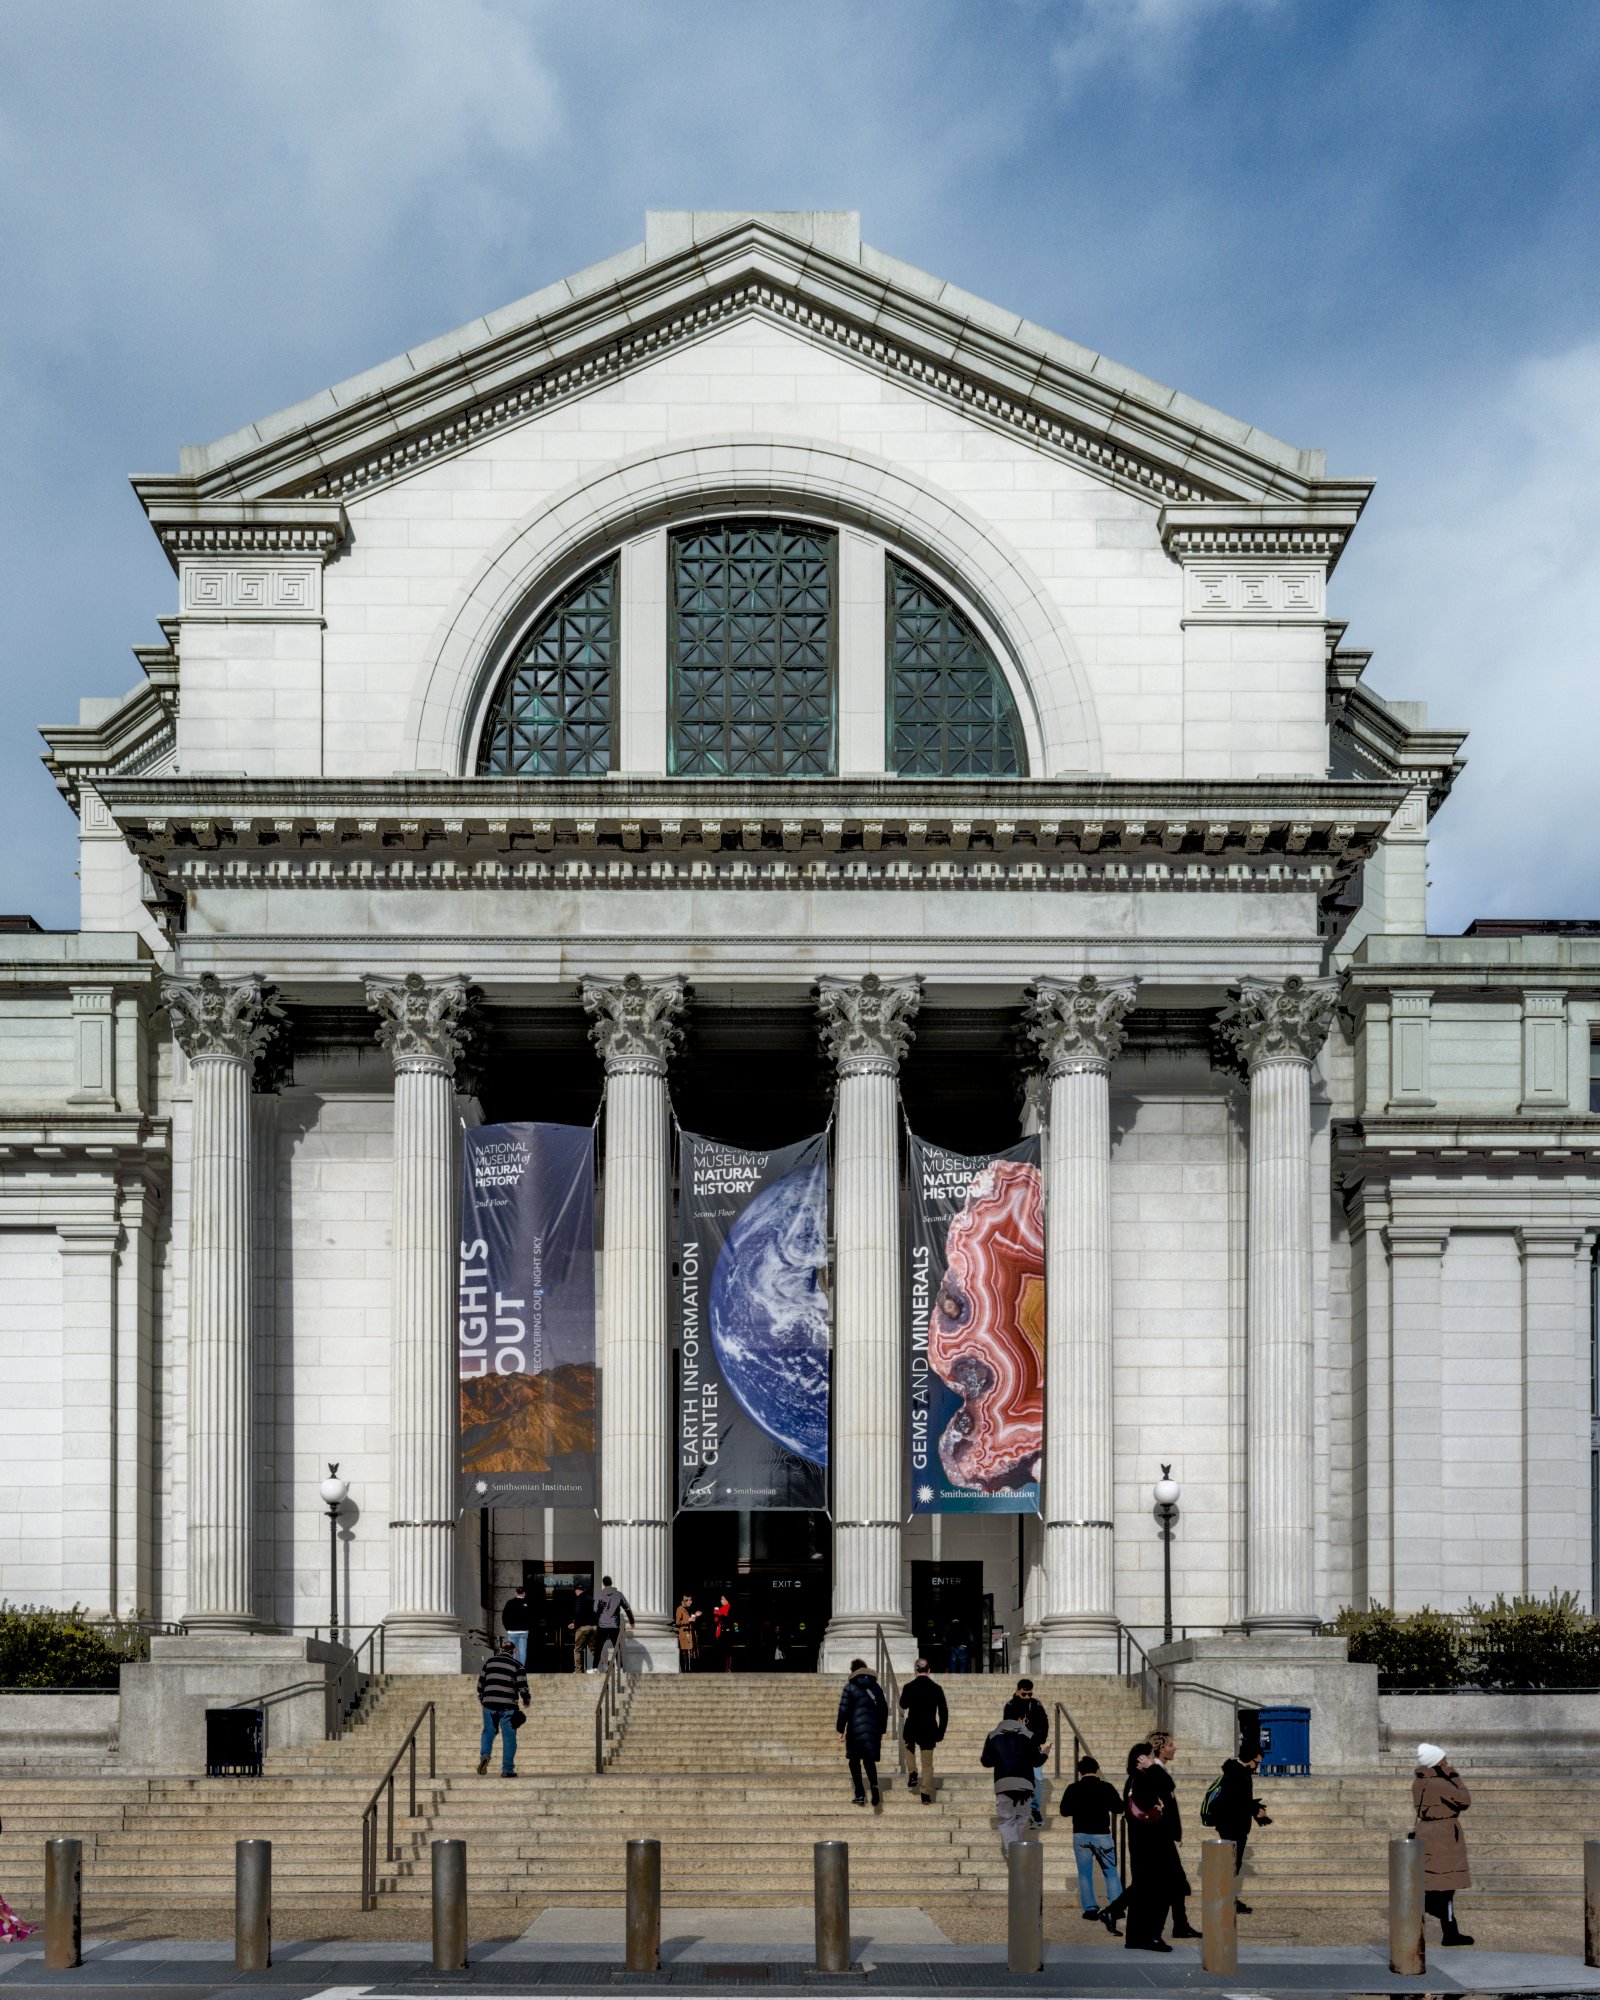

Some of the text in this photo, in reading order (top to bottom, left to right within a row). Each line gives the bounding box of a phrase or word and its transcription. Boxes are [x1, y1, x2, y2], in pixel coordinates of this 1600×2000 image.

[475, 1141, 528, 1155] NATIONAL
[475, 1153, 531, 1166] MUSEUM of
[693, 1154, 770, 1168] MUSEUM of
[922, 1158, 985, 1173] MUSEUM
[475, 1164, 525, 1177] NATURAL
[693, 1167, 762, 1182] NATURAL
[475, 1175, 519, 1187] HISTORY
[693, 1181, 756, 1196] HISTORY
[475, 1198, 509, 1208] 2nd Floor
[693, 1209, 736, 1219] Second Floor
[922, 1214, 946, 1223] Second
[459, 1238, 489, 1380] LIGHTS
[534, 1236, 542, 1375] RECOVERING OUR NIGHT SKY
[494, 1291, 526, 1376] OUT
[683, 1242, 699, 1467] EARTH INFORMATION
[912, 1246, 929, 1470] GEMS AND MINERALS
[702, 1382, 718, 1466] CENTER
[491, 1482, 583, 1492] Smithsonian Institution
[689, 1487, 712, 1495] NASA
[733, 1487, 777, 1495] Smithsonian
[940, 1489, 1035, 1498] Smithsonian Institution
[704, 1579, 723, 1588] EXIT
[772, 1580, 791, 1588] EXIT
[931, 1577, 961, 1586] ENTER
